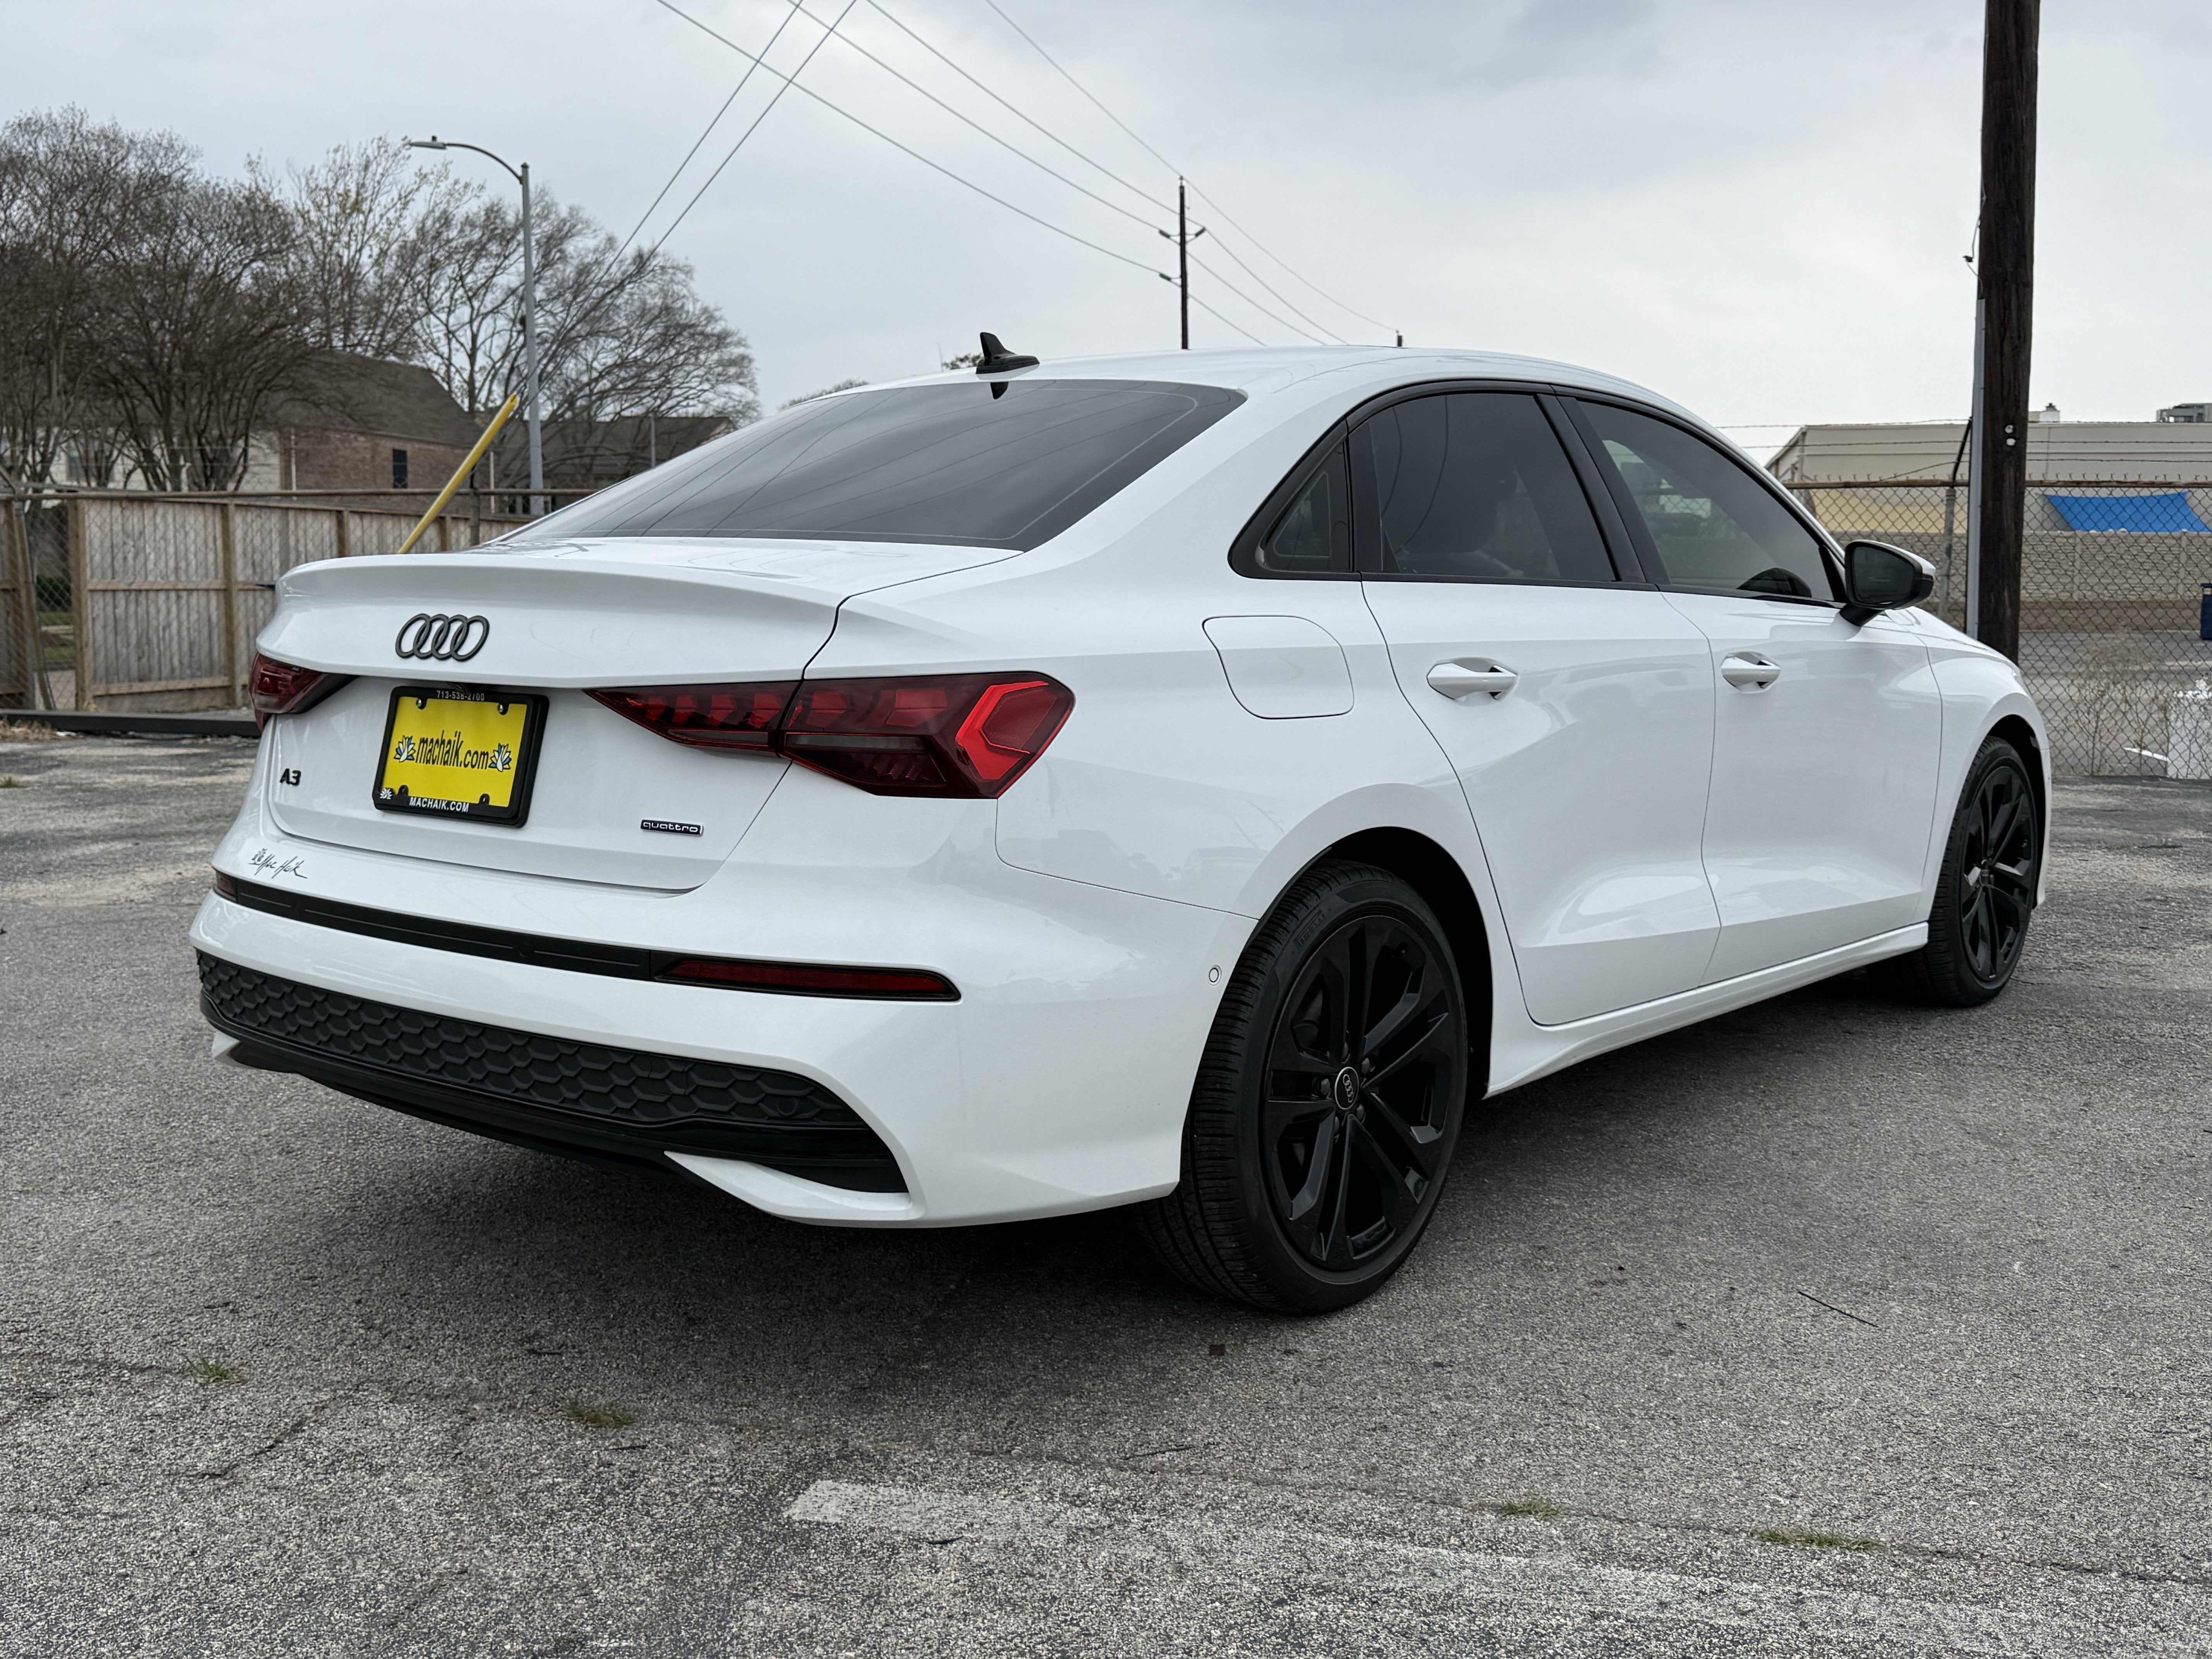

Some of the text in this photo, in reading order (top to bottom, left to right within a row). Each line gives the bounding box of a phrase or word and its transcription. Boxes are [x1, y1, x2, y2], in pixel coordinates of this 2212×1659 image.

[416, 730, 489, 769] machaik.com
[279, 768, 301, 786] A3
[409, 797, 469, 812] MACHAIK.COM
[643, 821, 698, 833] quattro
